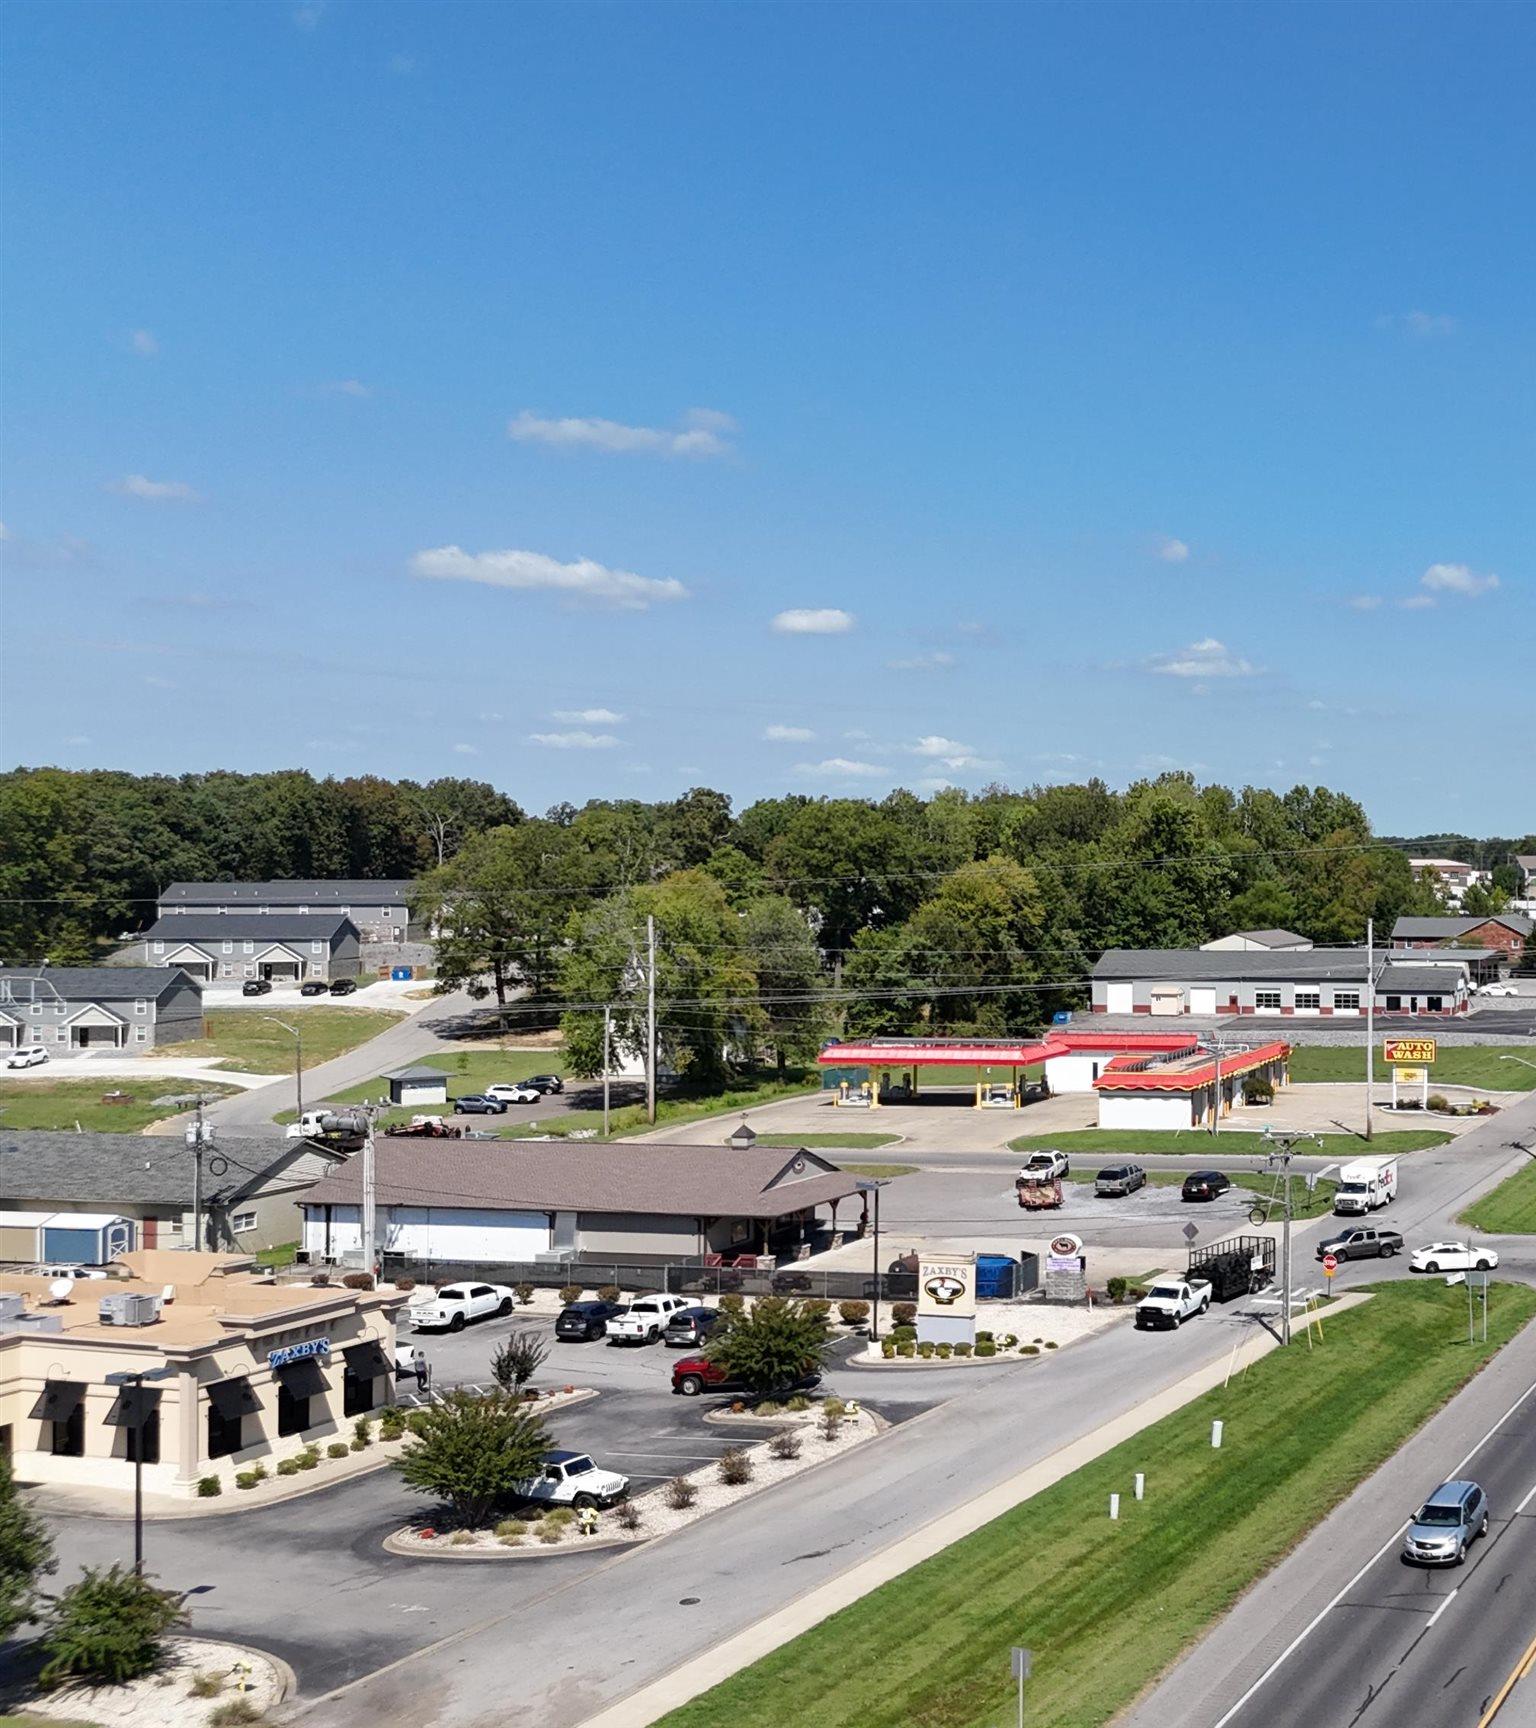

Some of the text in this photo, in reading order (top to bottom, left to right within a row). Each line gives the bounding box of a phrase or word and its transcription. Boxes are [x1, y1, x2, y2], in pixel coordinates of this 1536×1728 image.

[1396, 1042, 1433, 1051] AUTO
[1392, 1050, 1432, 1060] WASH
[922, 1266, 968, 1280] ZAXBY'S
[271, 1338, 330, 1368] ZAXBY'S
